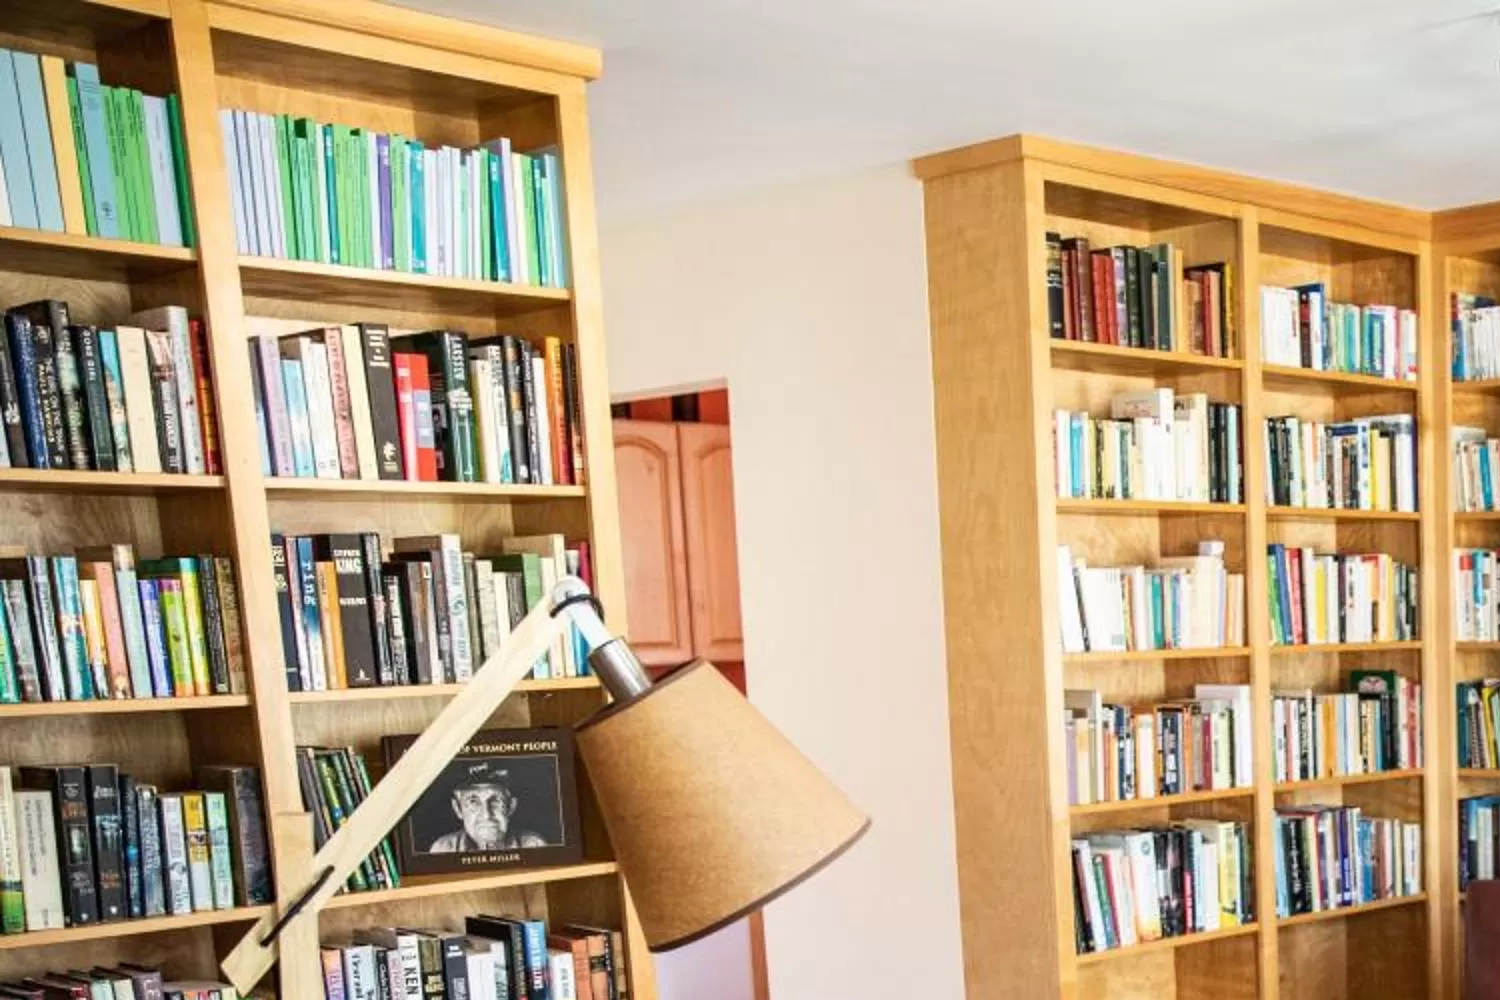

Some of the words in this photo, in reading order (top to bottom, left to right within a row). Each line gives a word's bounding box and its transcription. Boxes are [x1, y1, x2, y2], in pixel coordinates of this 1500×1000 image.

[82, 330, 93, 357] GONE
[86, 359, 97, 381] GIRL
[299, 559, 318, 608] ring
[472, 744, 520, 753] VERMONT
[523, 741, 558, 751] PEOPLE
[402, 966, 421, 996] KEN
